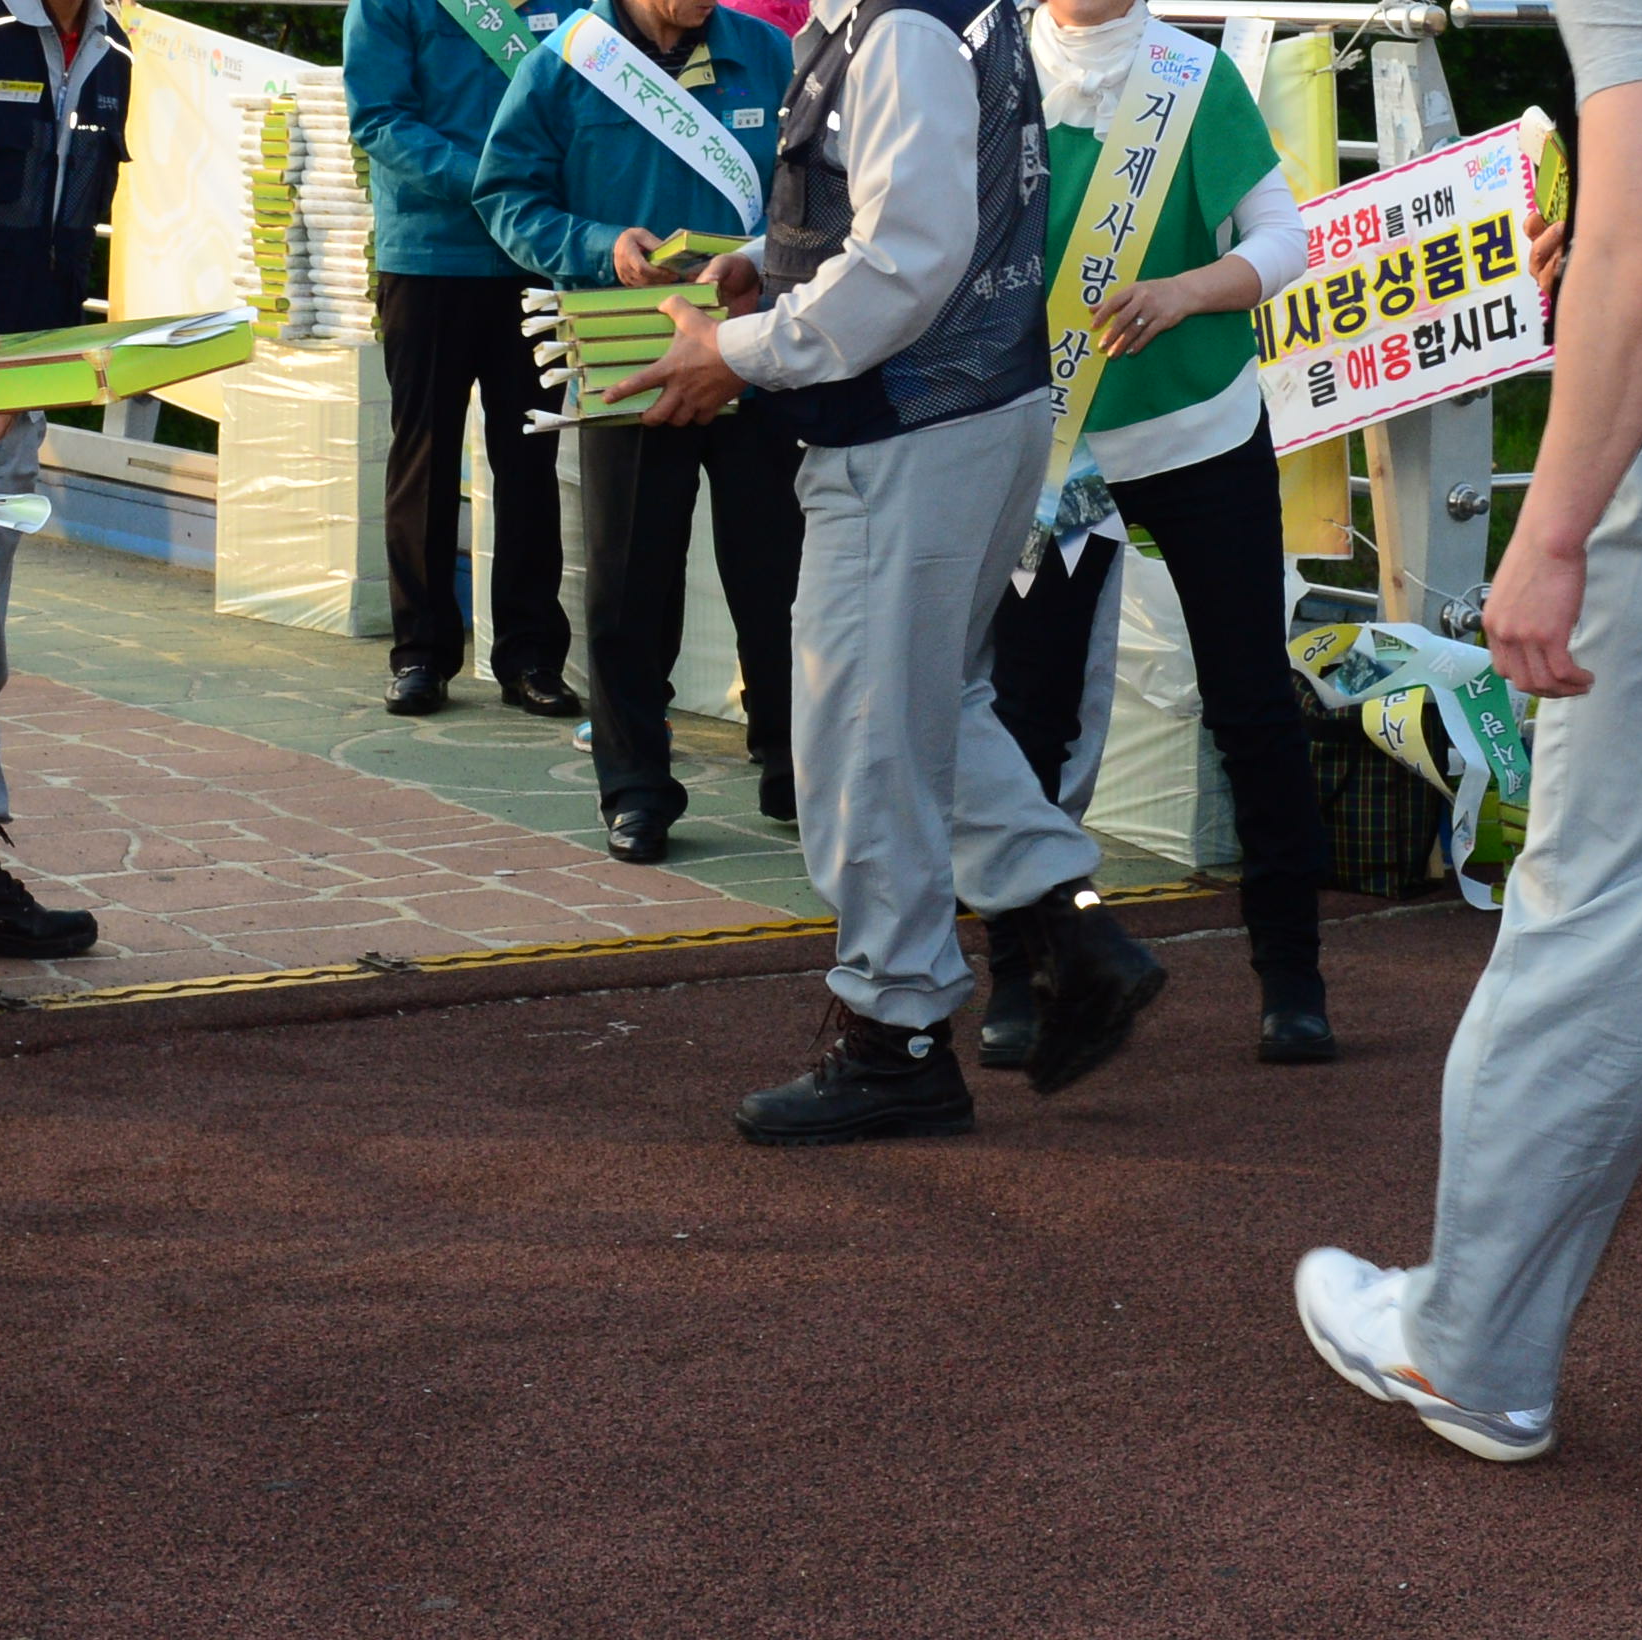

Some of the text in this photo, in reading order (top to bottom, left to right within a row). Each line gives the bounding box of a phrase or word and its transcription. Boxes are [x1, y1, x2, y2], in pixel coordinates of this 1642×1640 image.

[1149, 44, 1185, 61] Blue
[1151, 60, 1183, 78] City
[615, 62, 754, 199] 거제사랑 상품권
[1081, 90, 1178, 306] 거제사랑
[1411, 185, 1456, 228] 위해
[1307, 294, 1527, 408] 을 애용합시다.
